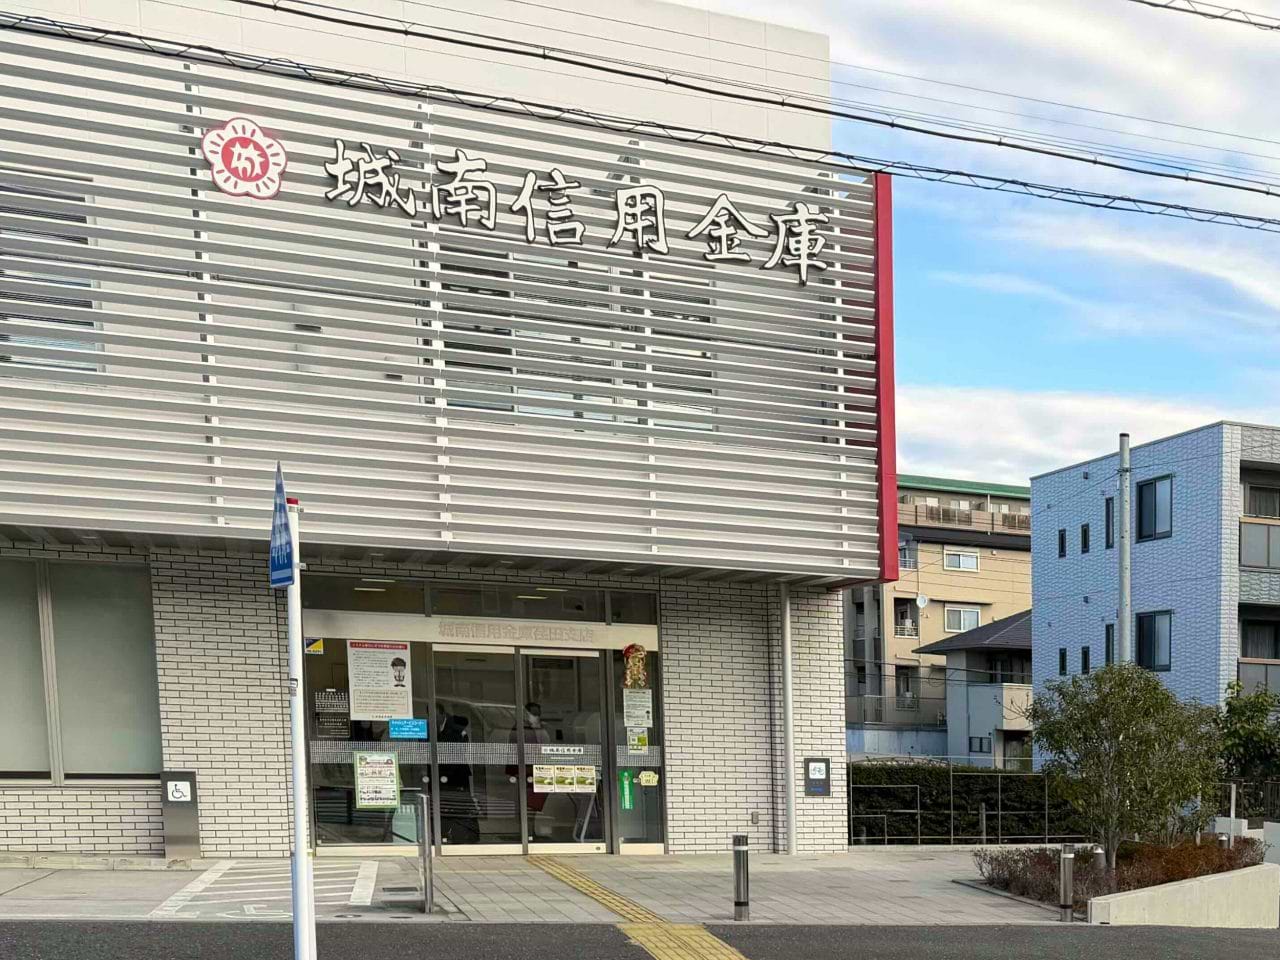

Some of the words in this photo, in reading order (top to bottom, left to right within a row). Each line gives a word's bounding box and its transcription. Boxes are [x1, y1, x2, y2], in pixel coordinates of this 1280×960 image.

[324, 138, 830, 286] 城南信用金庫
